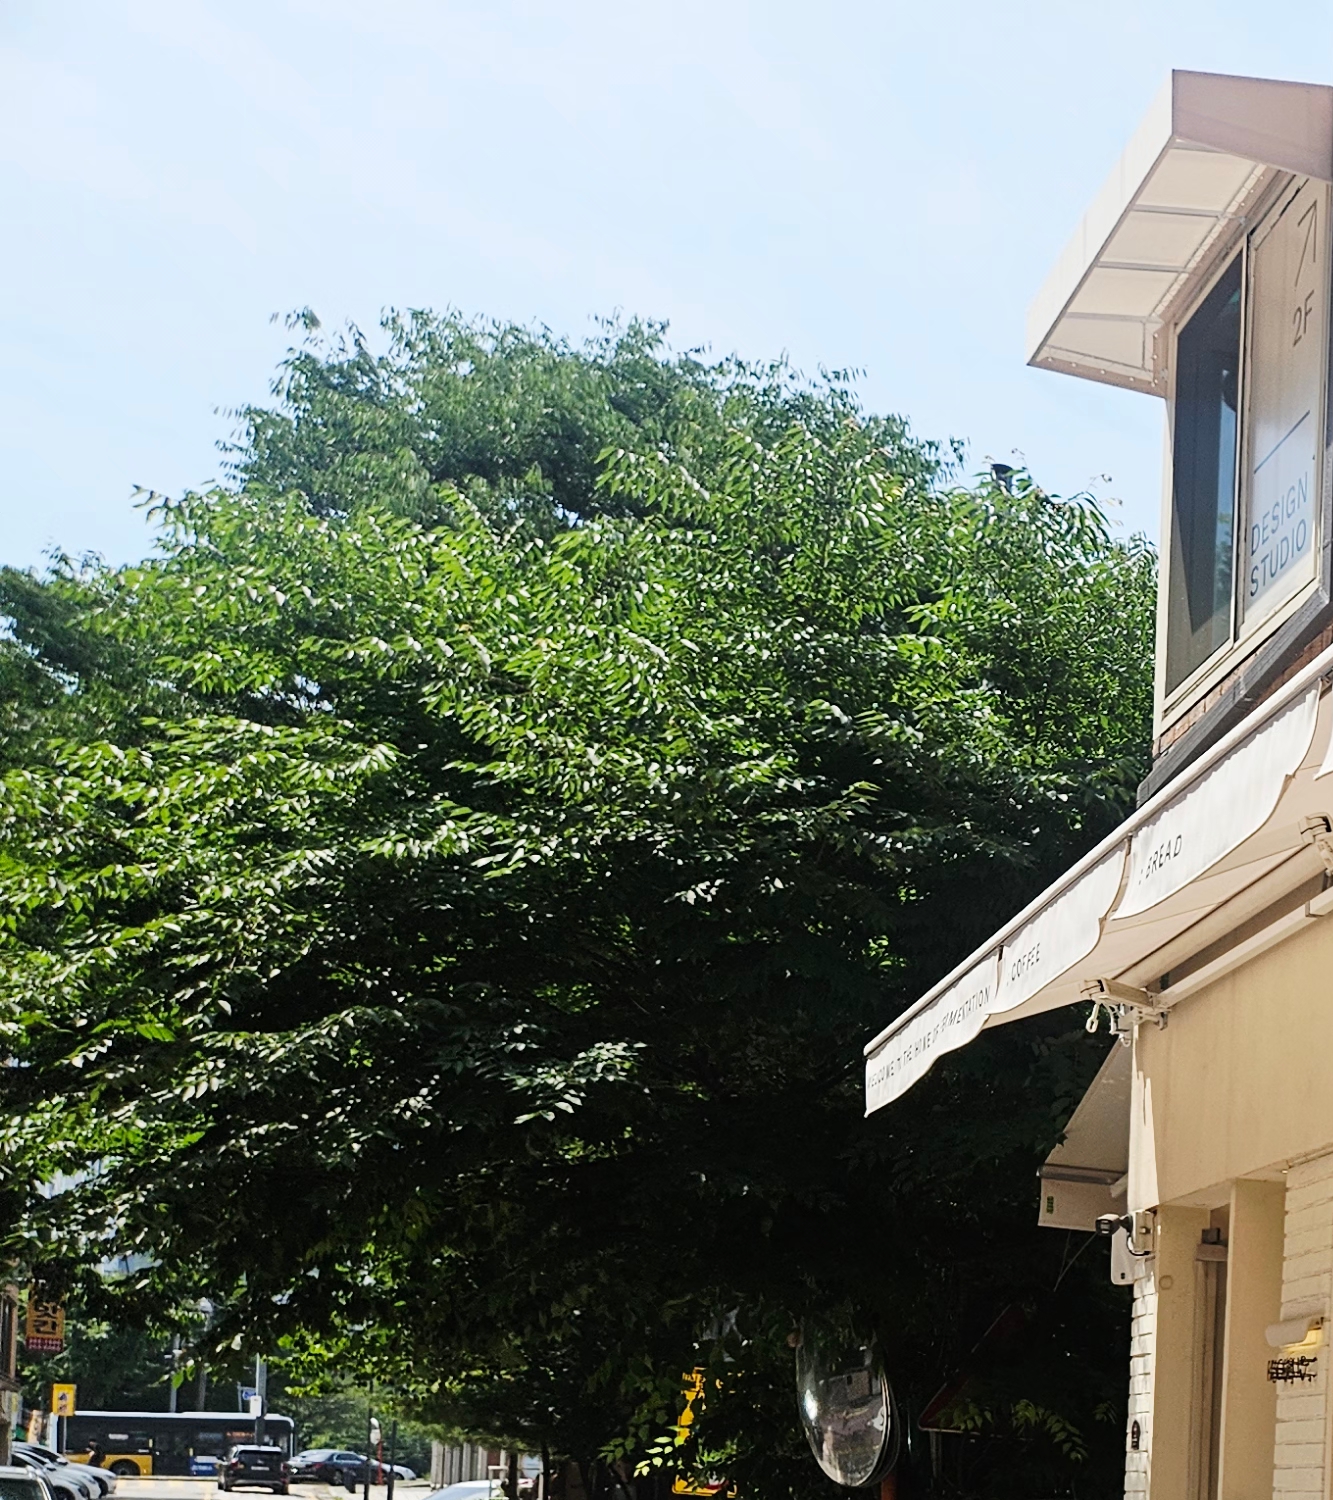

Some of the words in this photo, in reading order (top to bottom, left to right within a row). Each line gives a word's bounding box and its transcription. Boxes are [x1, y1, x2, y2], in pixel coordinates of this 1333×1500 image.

[1292, 289, 1314, 347] 2F
[1250, 471, 1309, 557] DESIGN
[1250, 518, 1307, 598] STUDIO
[1145, 834, 1183, 880] BREAD
